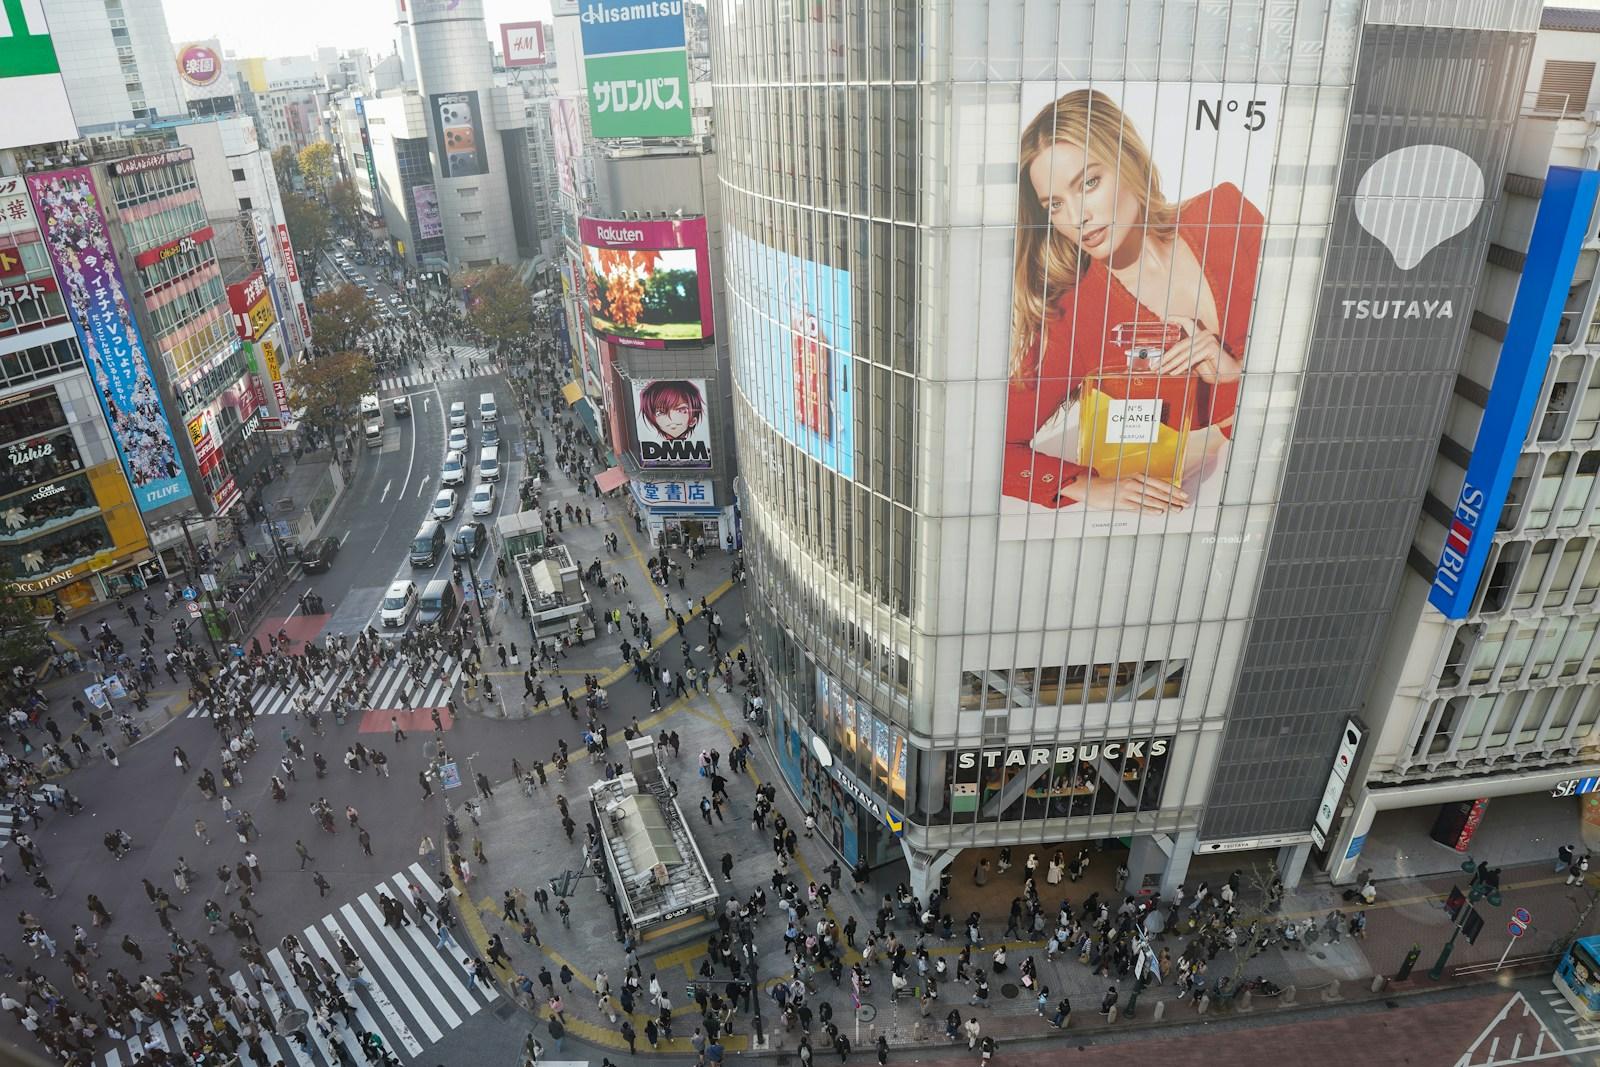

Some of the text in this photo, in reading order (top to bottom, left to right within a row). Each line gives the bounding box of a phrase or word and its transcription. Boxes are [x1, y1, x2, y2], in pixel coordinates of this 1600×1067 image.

[513, 36, 534, 51] H&M
[593, 77, 683, 112] サロンパス
[597, 226, 644, 243] Rakuten
[0, 283, 46, 307] ガスト
[1341, 299, 1454, 320] TSUTAYA
[241, 415, 260, 441] LUSH
[1111, 414, 1157, 423] CHANEL
[1434, 482, 1484, 596] SEIBU
[958, 740, 1168, 769] STARBUCKS
[836, 769, 881, 815] TSUTAYA
